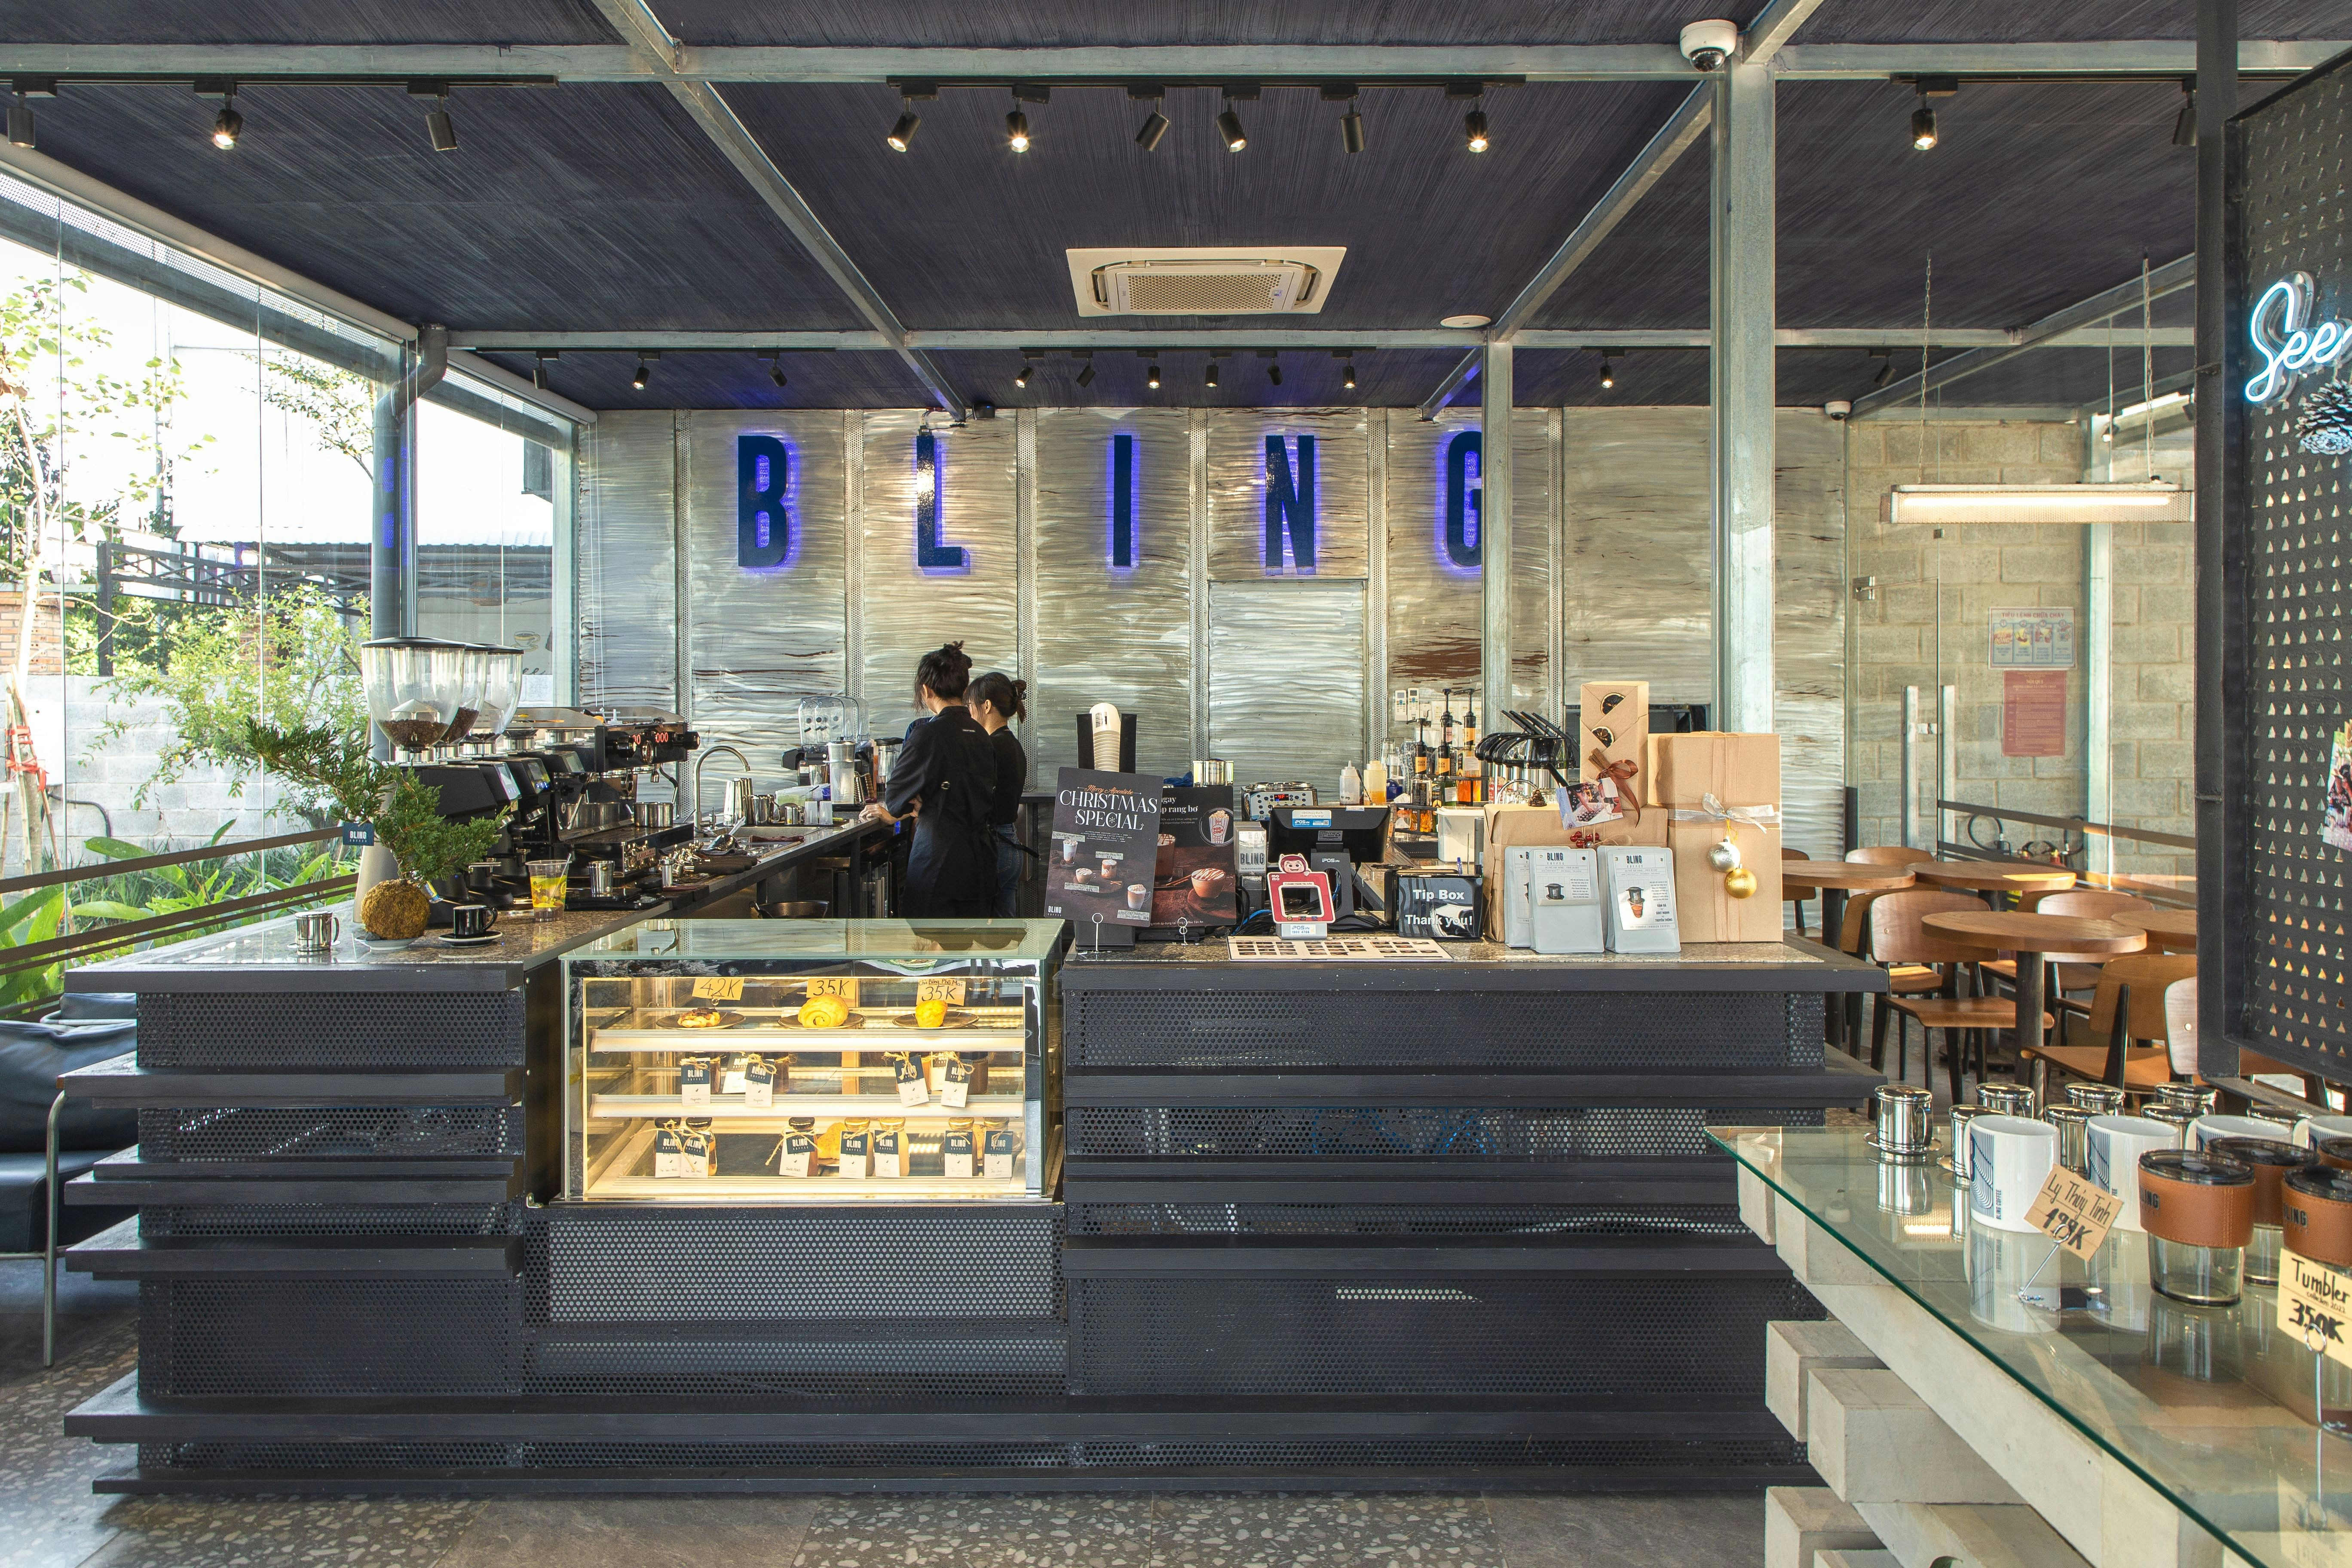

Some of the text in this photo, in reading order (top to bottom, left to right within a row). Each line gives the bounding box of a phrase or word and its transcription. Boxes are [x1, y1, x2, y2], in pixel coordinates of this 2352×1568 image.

[2245, 282, 2349, 402] See
[738, 434, 1482, 567] BLING
[1084, 784, 1134, 795] Merry Alpenliebe
[1060, 790, 1158, 814] CHRISTMAS
[1075, 809, 1145, 830] SPECIAL
[349, 830, 367, 839] BLING
[1240, 853, 1265, 865] BLING
[1547, 852, 1564, 861] BLING
[1626, 855, 1642, 864] BLING
[1413, 889, 1465, 902] Tip Box
[1405, 914, 1473, 928] Thank you!
[700, 978, 740, 998] 42K
[813, 980, 850, 996] 35K
[922, 986, 956, 1001] 35K
[687, 1069, 704, 1078] BLING
[792, 1138, 808, 1147] BLING
[846, 1139, 861, 1148] BLING
[951, 1139, 966, 1148] BLING
[2048, 1173, 2062, 1204] Ly
[2089, 1194, 2111, 1225] Tinh
[2139, 1185, 2160, 1210] LING
[2291, 1257, 2351, 1304] Tumbler
